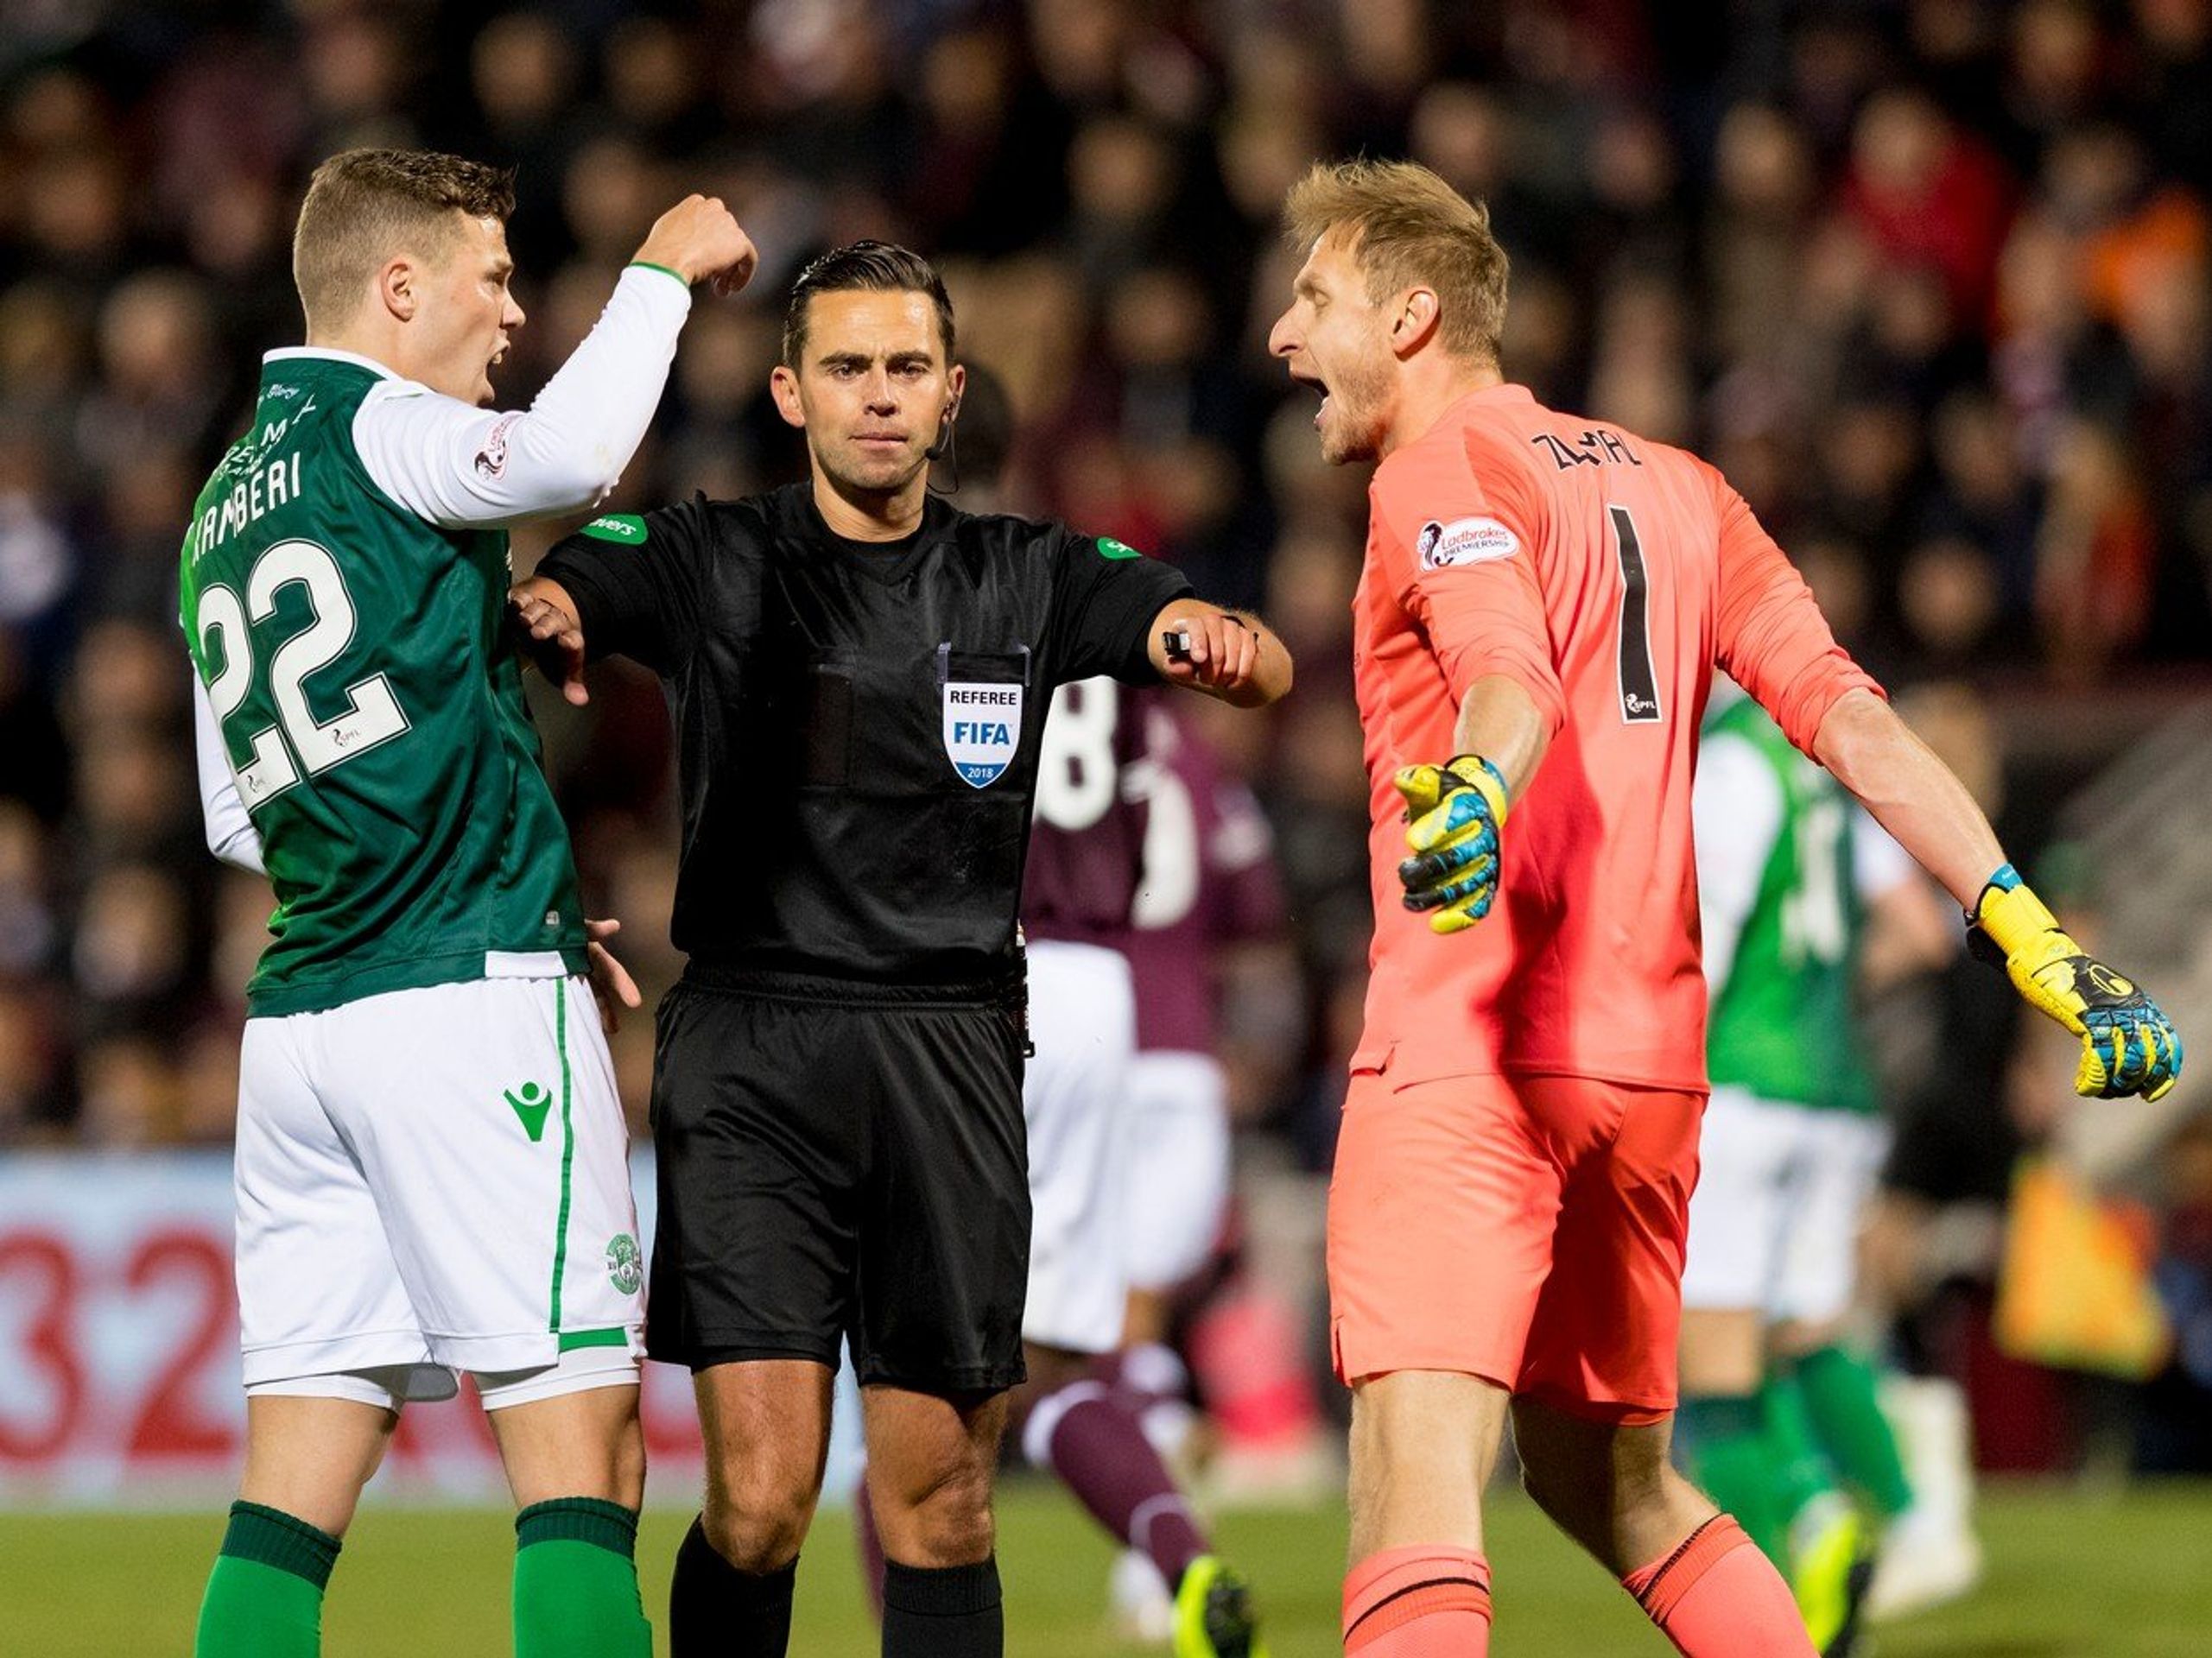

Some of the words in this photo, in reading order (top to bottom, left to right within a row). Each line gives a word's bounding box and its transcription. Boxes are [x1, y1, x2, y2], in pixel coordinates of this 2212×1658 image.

[1610, 505, 1661, 722] 1
[198, 539, 413, 813] 22
[950, 690, 1017, 706] REFEREE
[954, 722, 1010, 745] FIFA
[967, 767, 994, 779] 2018
